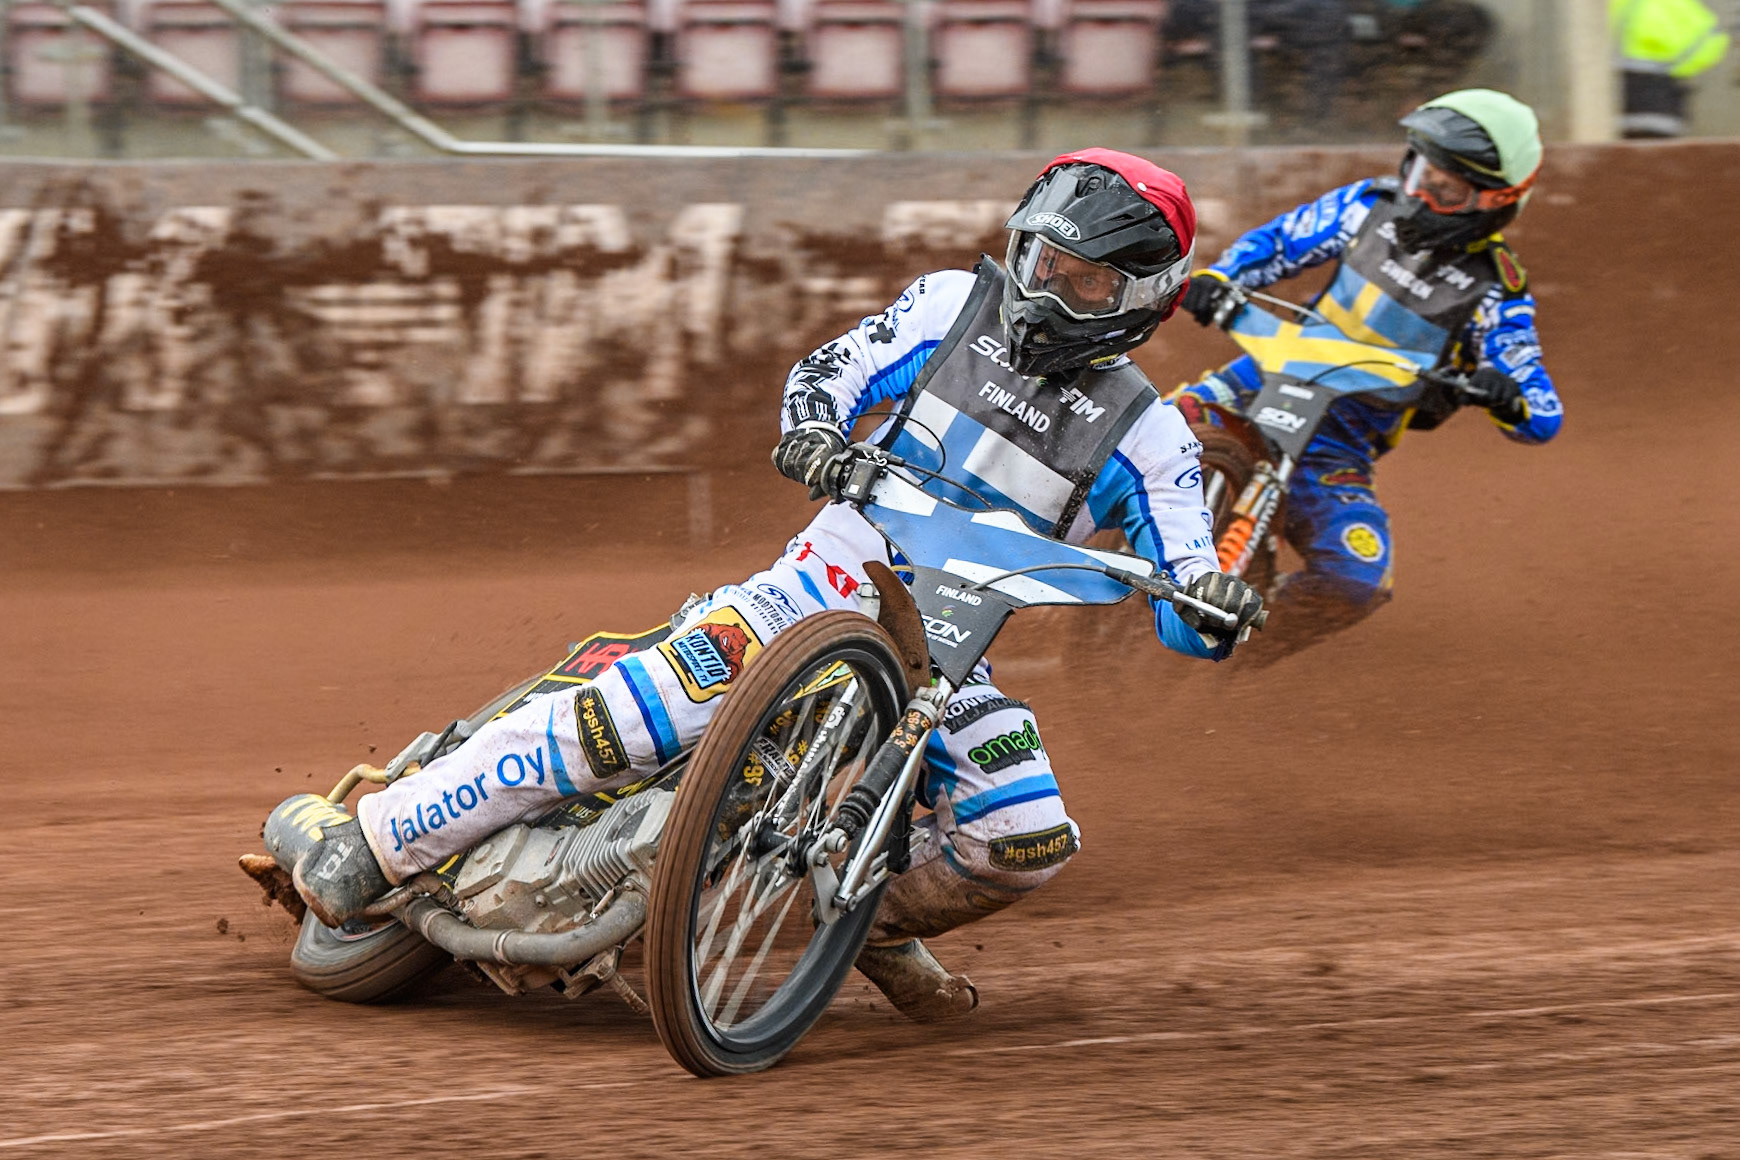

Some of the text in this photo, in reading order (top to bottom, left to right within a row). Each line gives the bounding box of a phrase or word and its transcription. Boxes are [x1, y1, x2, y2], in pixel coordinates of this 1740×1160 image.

[1031, 213, 1079, 240] SHOEI
[978, 380, 1051, 433] FINLAND
[1059, 386, 1106, 423] FIM
[935, 584, 983, 607] FINLAND
[685, 633, 727, 677] KONTIO
[582, 697, 618, 765] #gsh457
[390, 745, 546, 853] Jalator Oy
[1004, 833, 1069, 864] #gsh457
